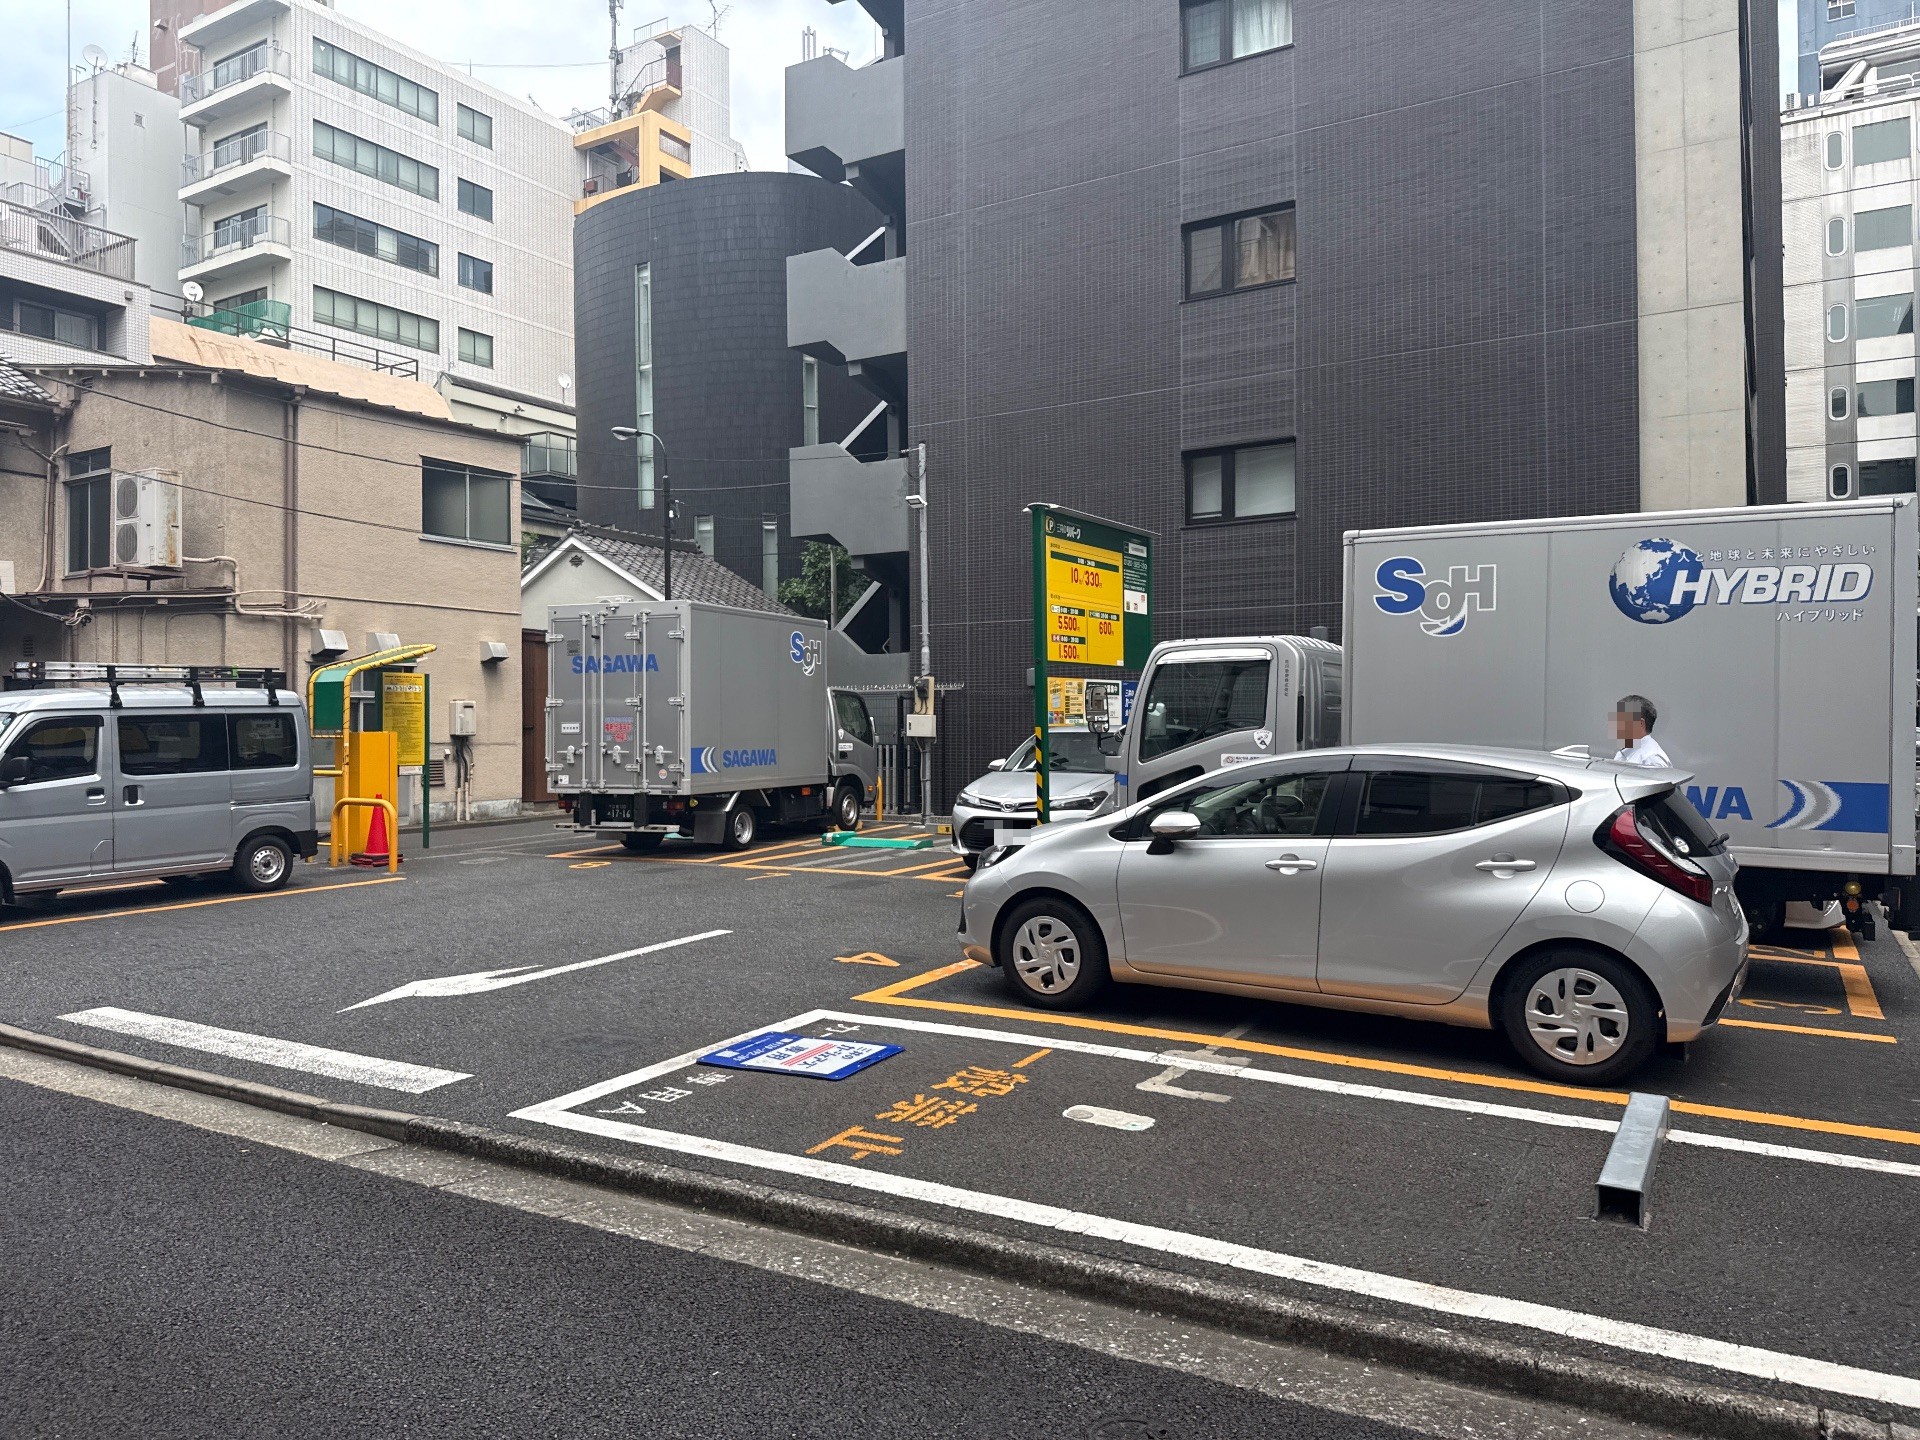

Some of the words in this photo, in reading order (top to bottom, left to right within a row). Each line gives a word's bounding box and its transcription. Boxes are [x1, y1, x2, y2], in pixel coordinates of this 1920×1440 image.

[1678, 544, 1877, 564] 人と地球と未来にやさしい
[1669, 562, 1875, 605] HYBRID
[1776, 609, 1864, 623] ハイブリッド
[572, 653, 659, 674] SAGAWA
[722, 749, 777, 768] SAGAWA
[612, 809, 631, 818] 17-16
[832, 951, 901, 968] 4
[1736, 998, 1843, 1015] 3
[765, 1044, 810, 1060] 専用
[841, 1045, 873, 1060] 三井の
[805, 1048, 1054, 1161] 一般禁止
